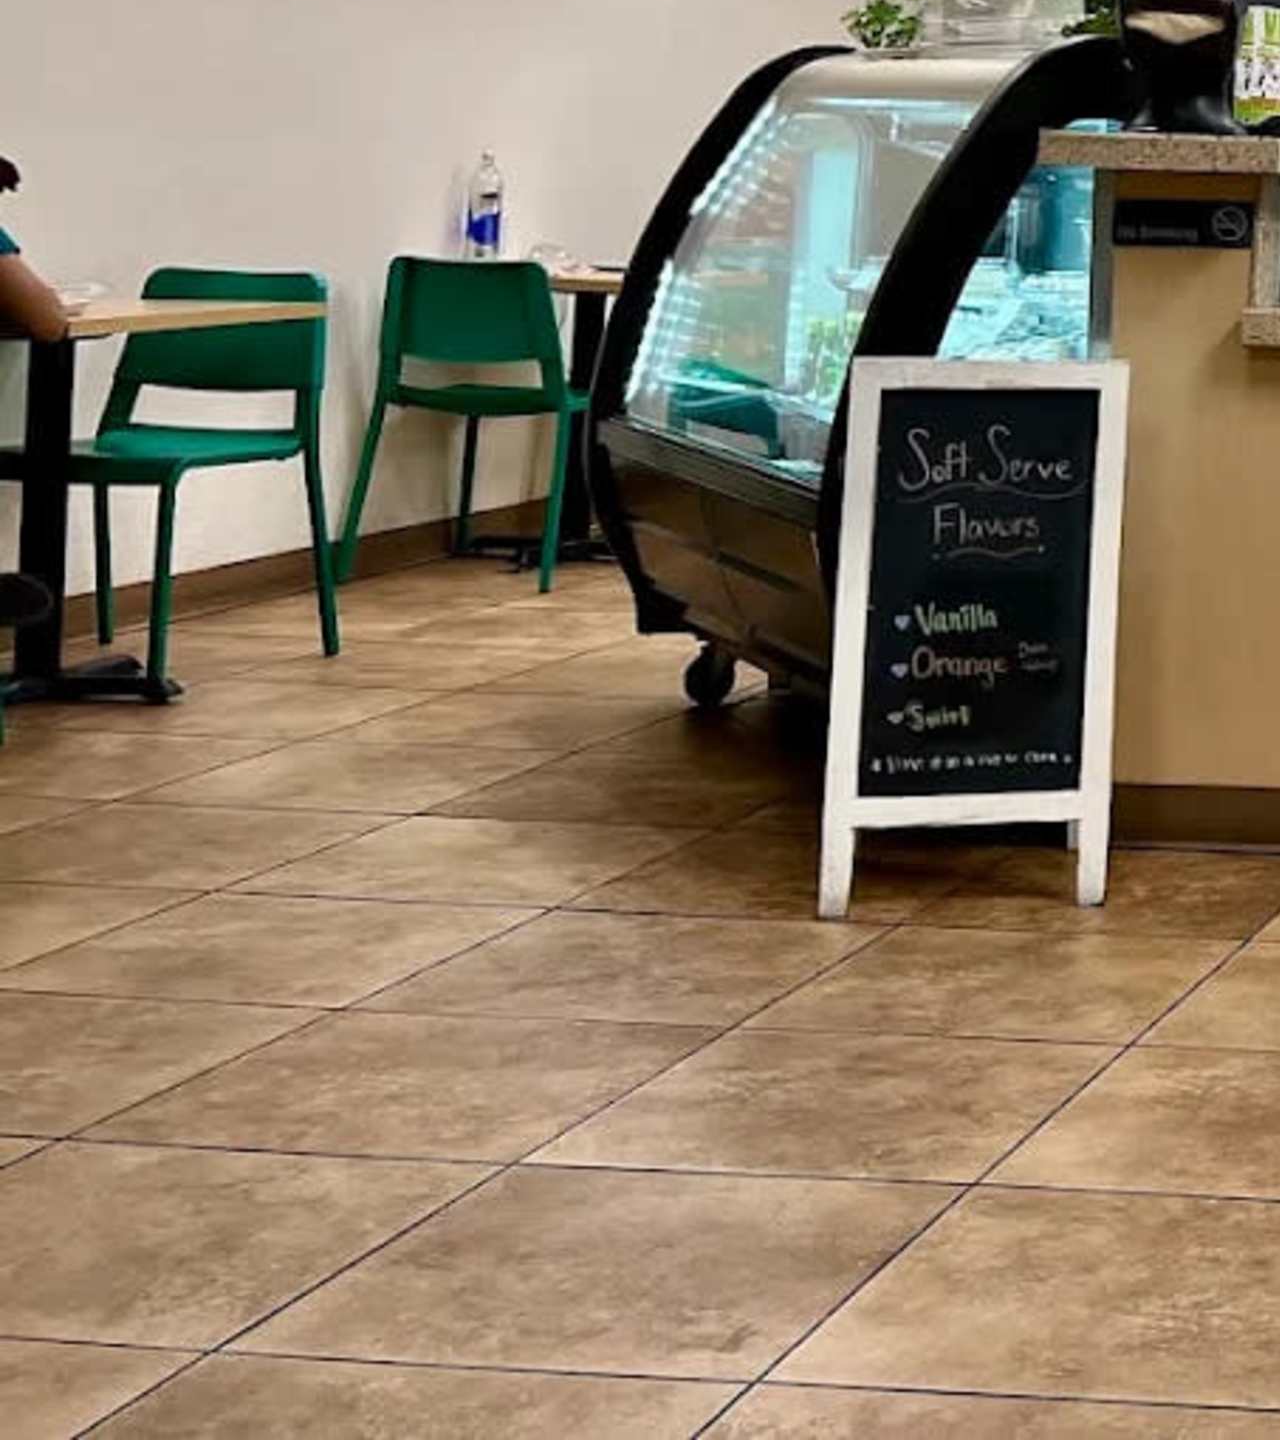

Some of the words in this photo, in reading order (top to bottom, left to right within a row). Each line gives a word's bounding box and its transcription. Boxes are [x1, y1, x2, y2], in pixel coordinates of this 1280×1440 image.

[899, 427, 975, 492] Soft
[977, 424, 1073, 488] Serve
[932, 502, 1041, 545] Flavors
[913, 601, 998, 636] Vanilla
[911, 645, 1009, 690] Orange
